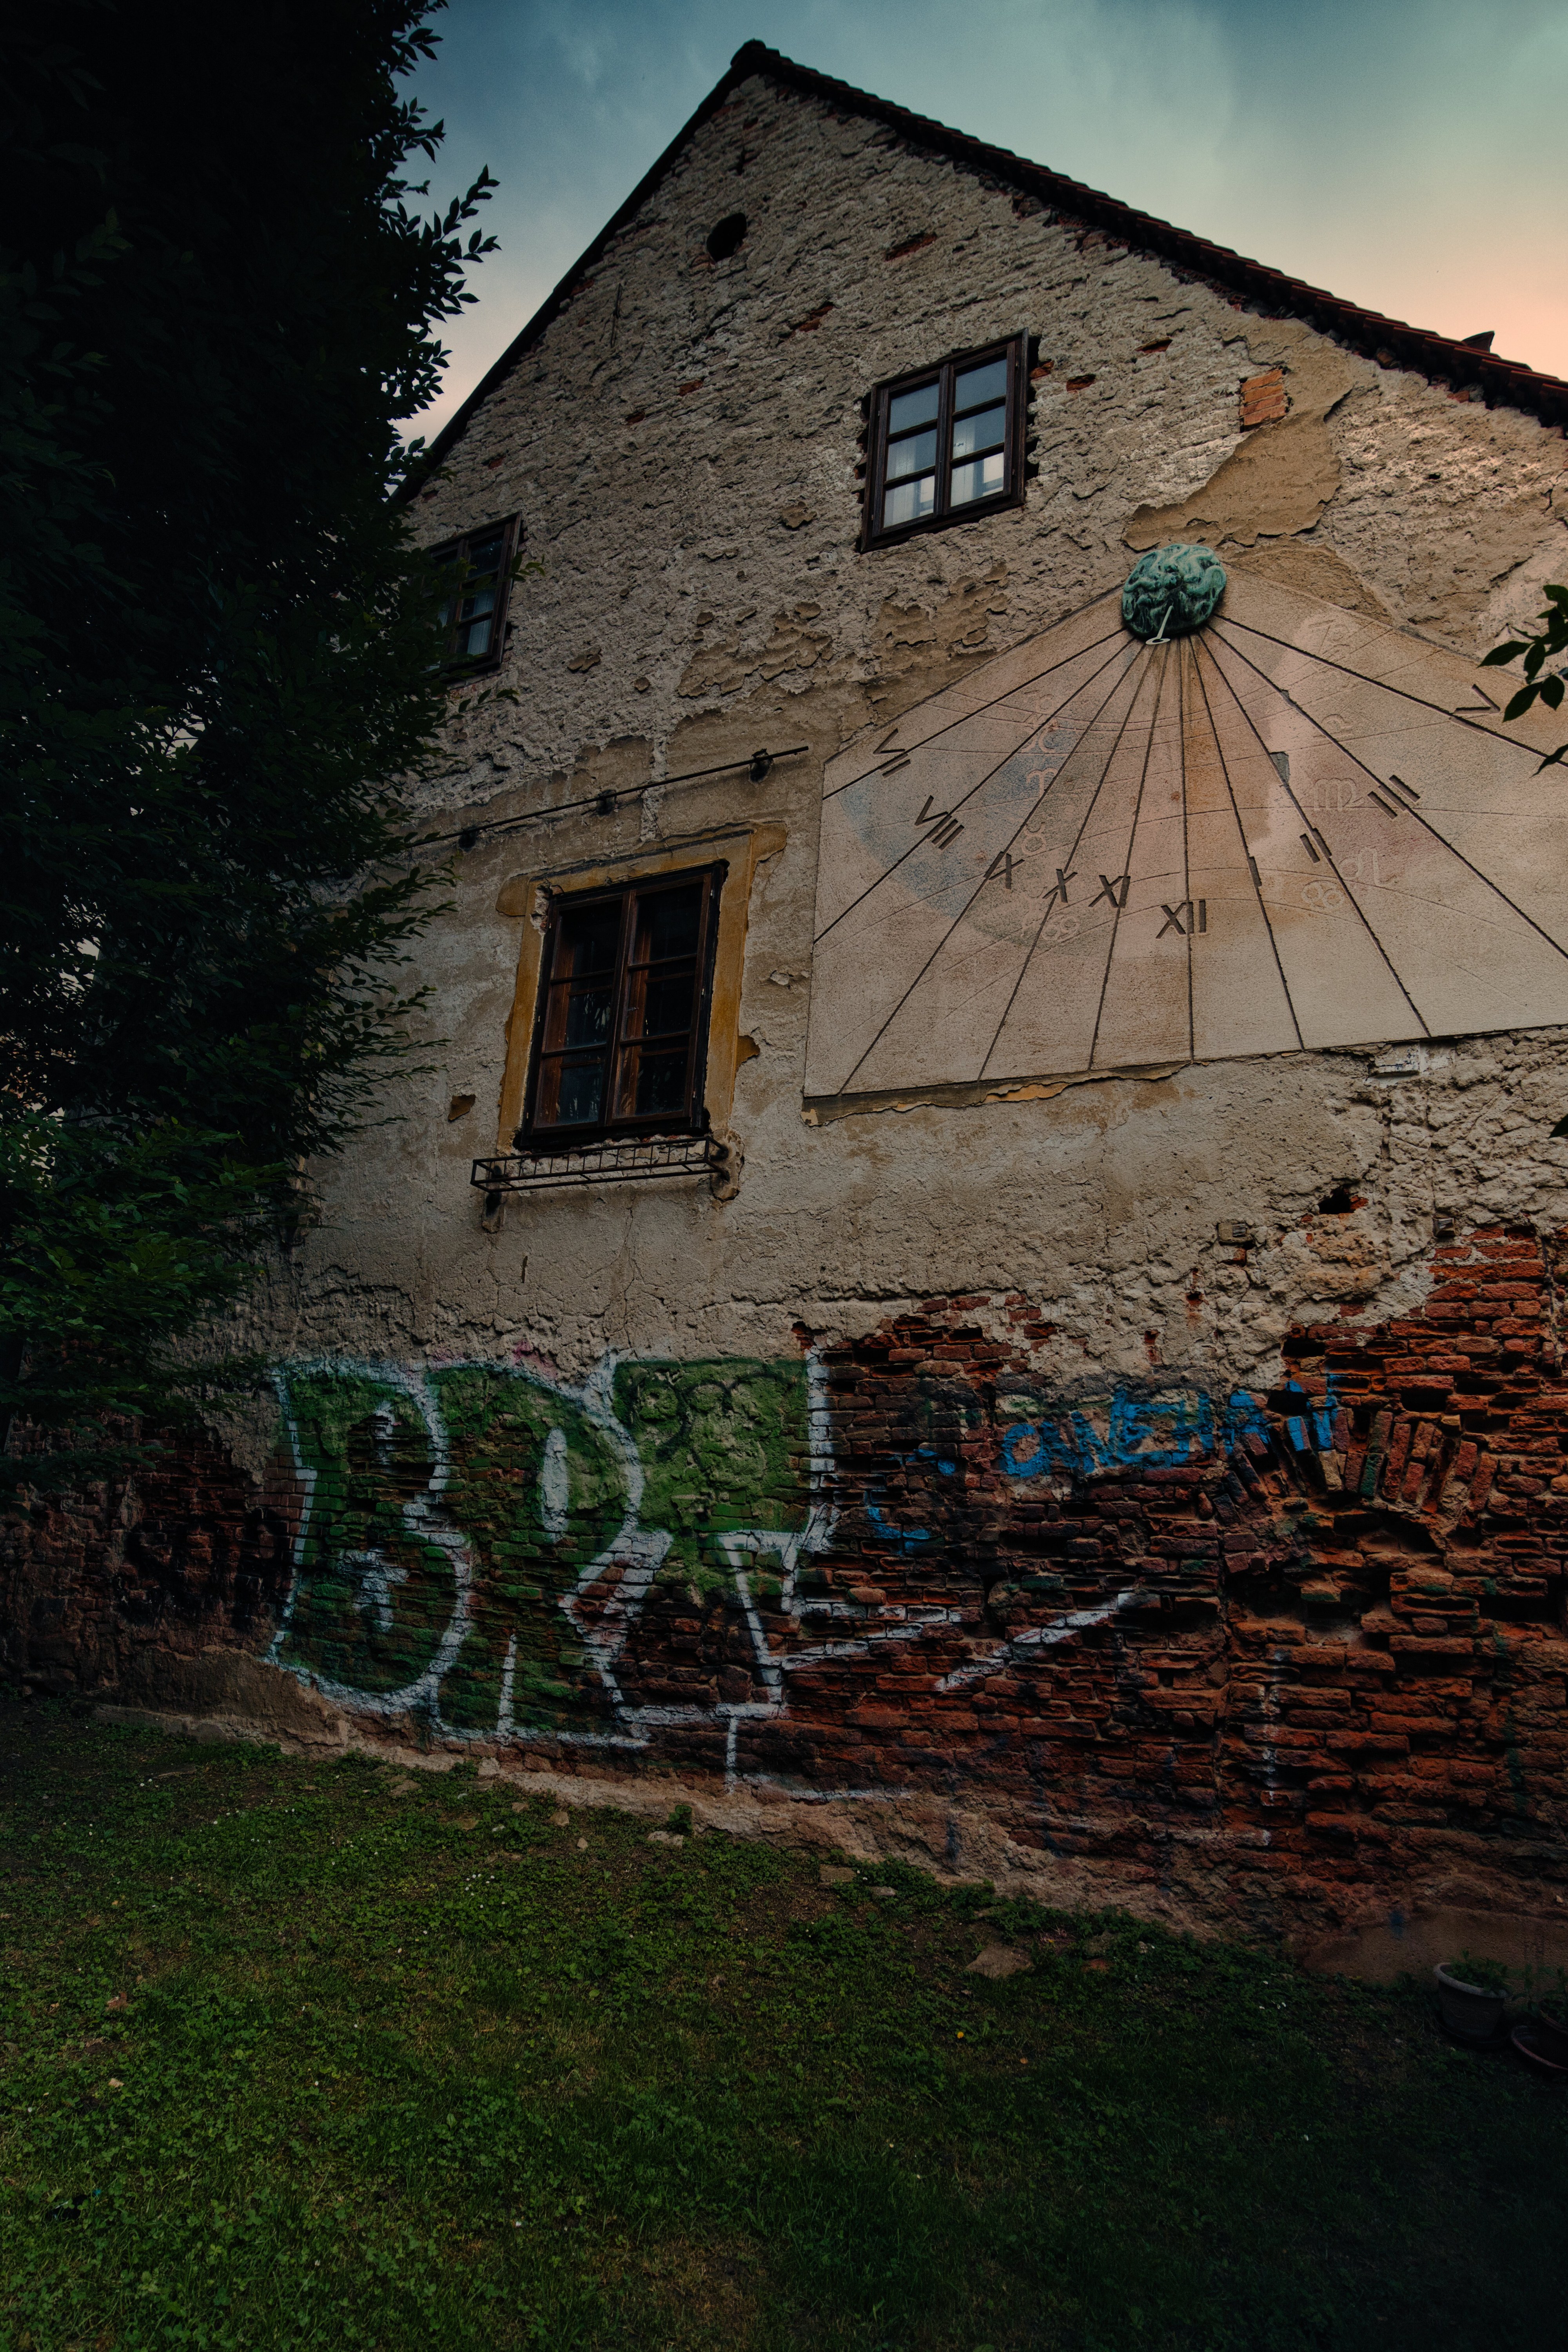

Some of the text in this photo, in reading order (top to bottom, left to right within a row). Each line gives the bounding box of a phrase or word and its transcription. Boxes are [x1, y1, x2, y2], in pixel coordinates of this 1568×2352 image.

[873, 728, 911, 779] VII
[1367, 775, 1421, 819] III
[915, 795, 965, 850] VIII
[1299, 828, 1332, 863] II
[983, 851, 1025, 890] IX
[1042, 869, 1078, 903] X
[1088, 875, 1131, 908] XI
[1156, 899, 1206, 939] XII
